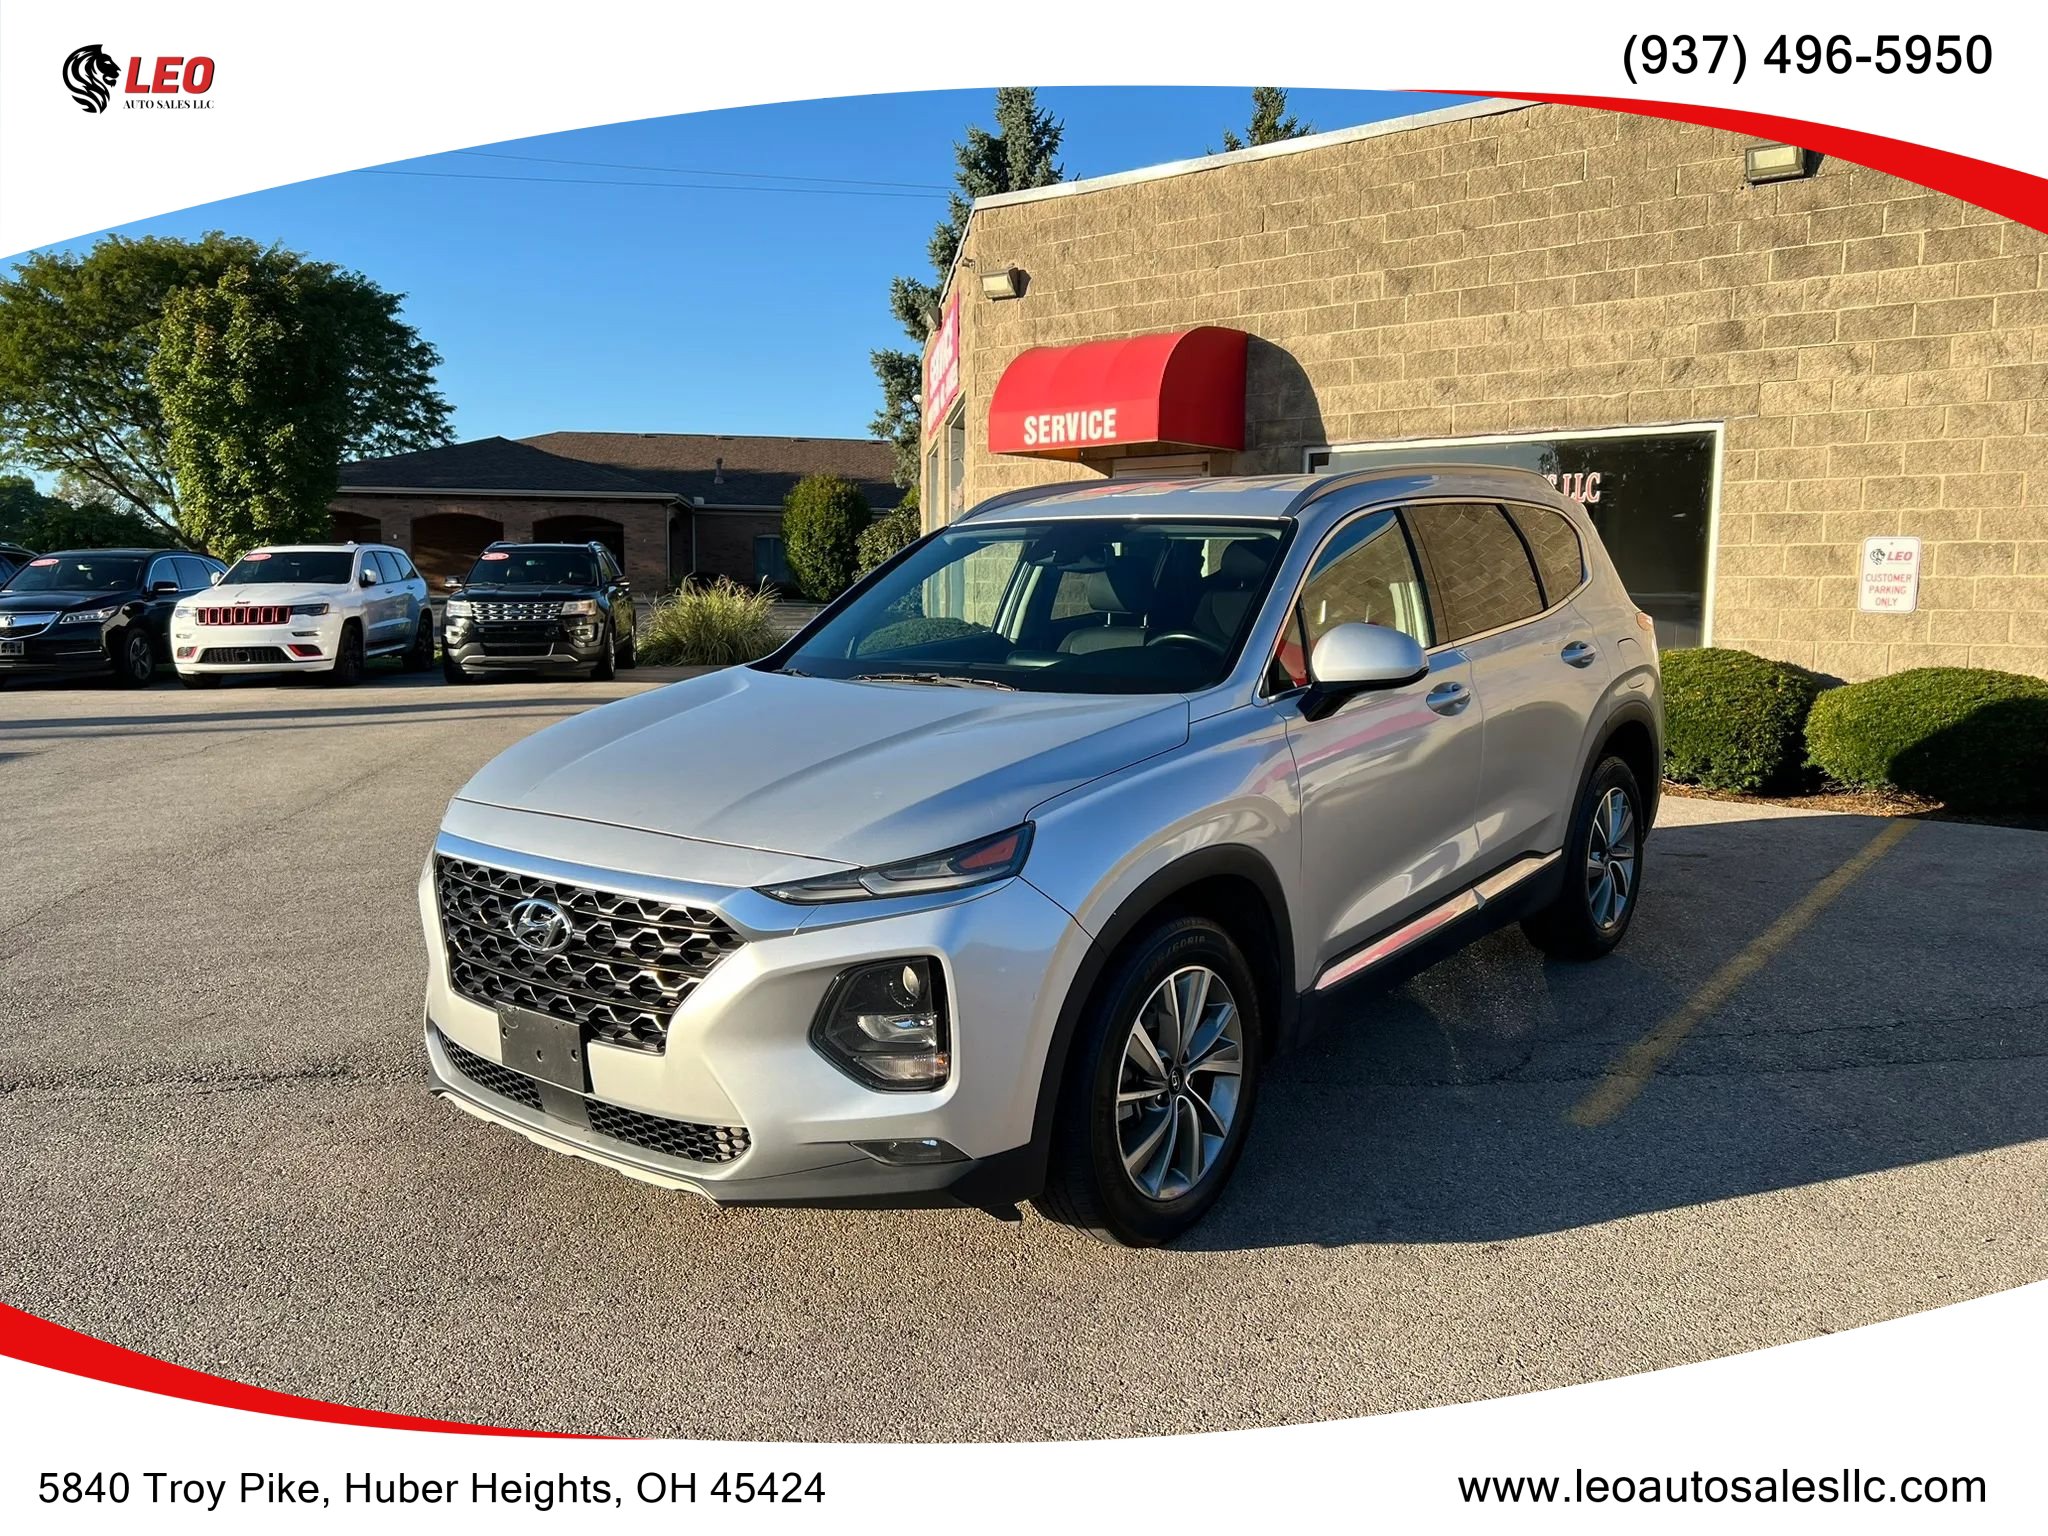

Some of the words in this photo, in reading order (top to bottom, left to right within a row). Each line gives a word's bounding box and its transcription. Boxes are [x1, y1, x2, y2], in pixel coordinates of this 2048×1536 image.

[1024, 408, 1116, 445] SERVICE
[1887, 551, 1913, 561] LEO
[1865, 573, 1912, 583] CUSTOMER
[1868, 585, 1906, 595] PARKING
[1875, 597, 1897, 607] ONLY
